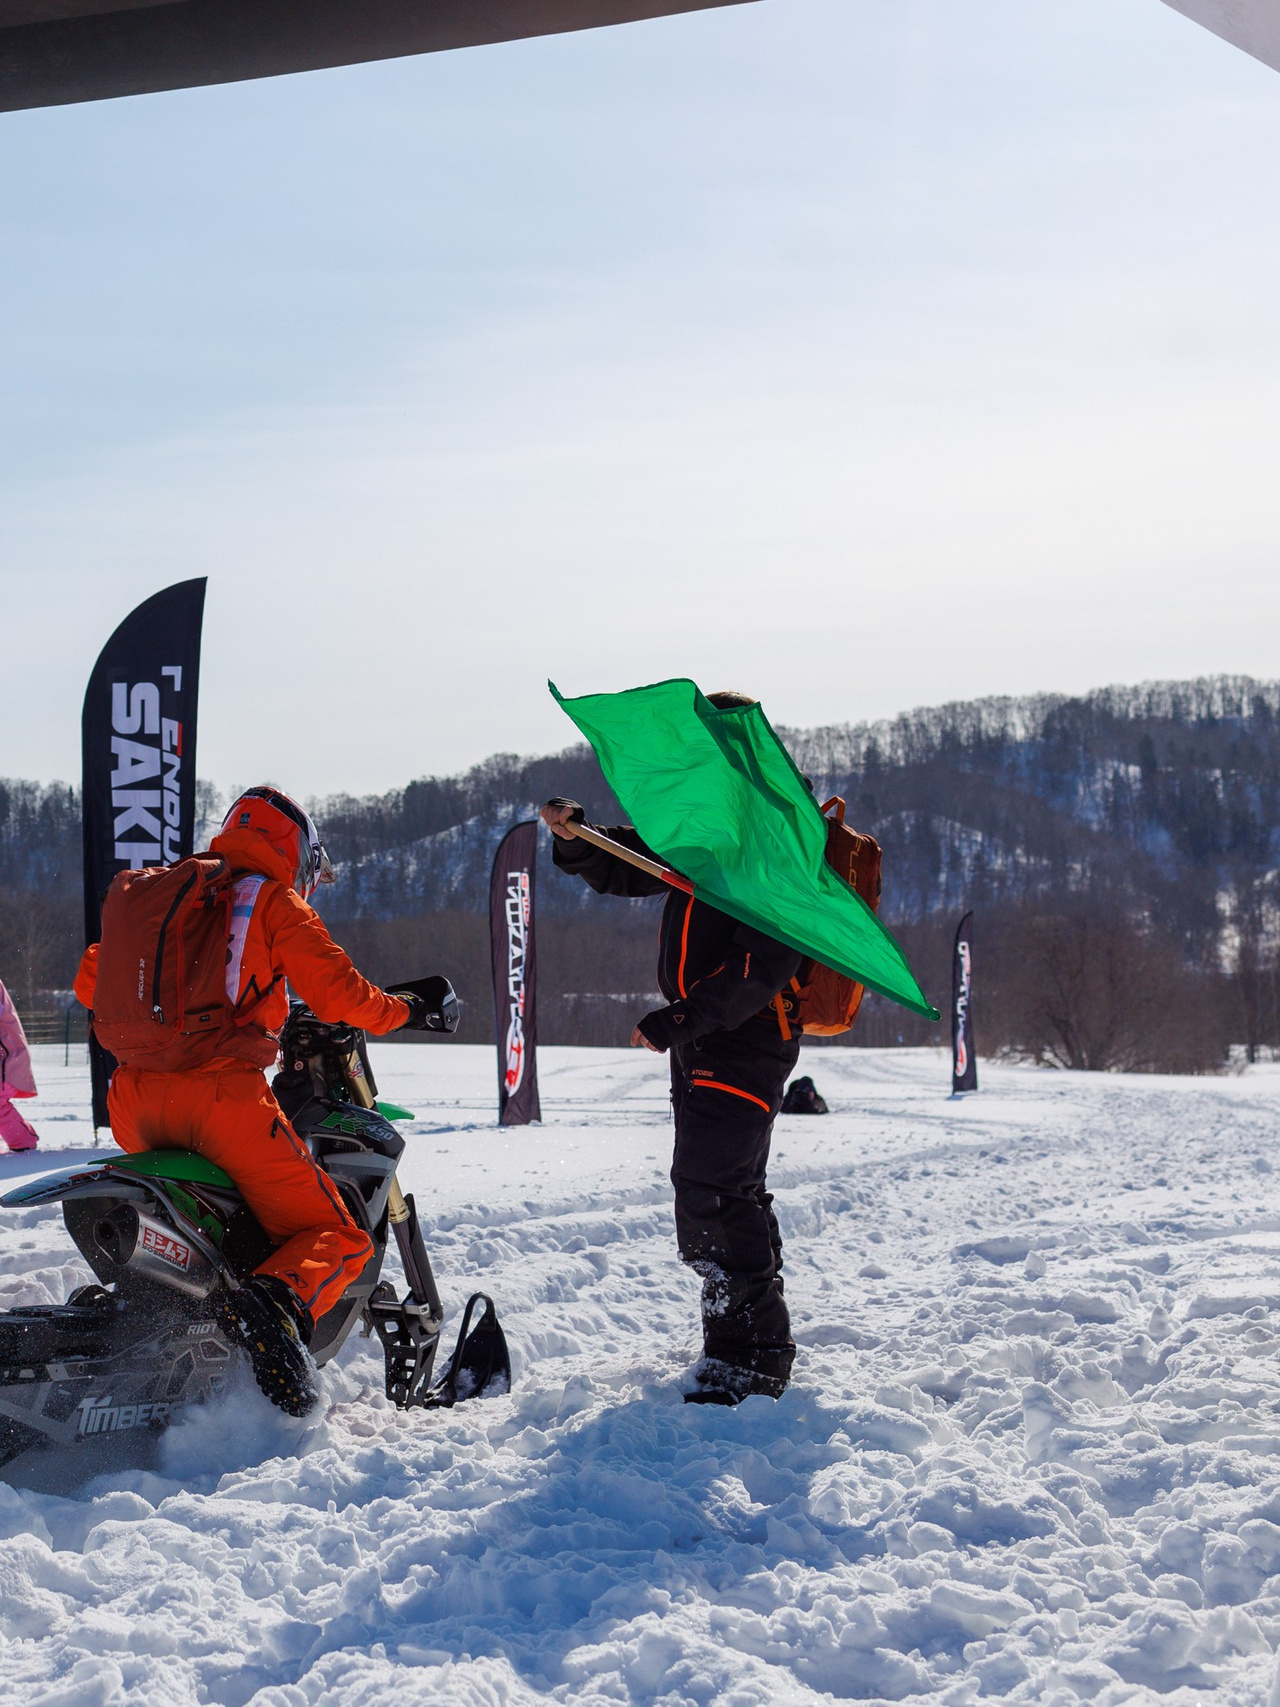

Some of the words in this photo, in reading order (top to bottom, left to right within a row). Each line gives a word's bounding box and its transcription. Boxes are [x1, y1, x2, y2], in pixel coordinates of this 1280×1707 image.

[162, 717, 182, 867] ENDU
[145, 1229, 188, 1261] ヨシムラ
[187, 1323, 218, 1335] RIOT
